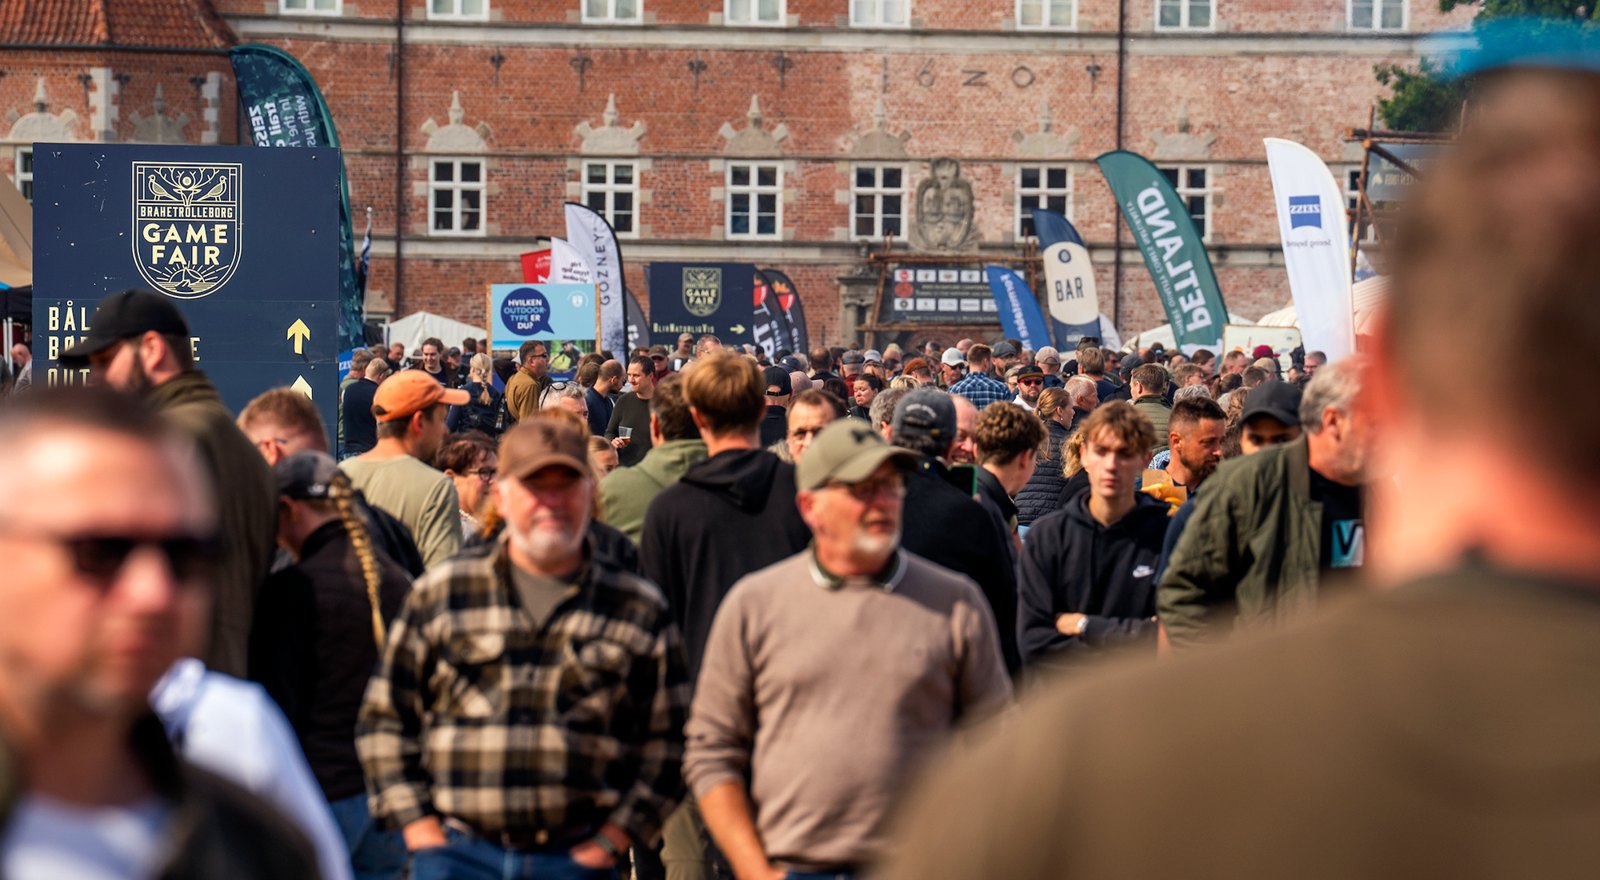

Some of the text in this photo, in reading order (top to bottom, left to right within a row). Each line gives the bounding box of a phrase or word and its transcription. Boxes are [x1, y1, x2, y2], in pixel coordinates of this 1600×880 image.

[140, 206, 233, 218] BRAHETROLLEBORG
[143, 223, 228, 244] GAME
[152, 245, 220, 266] FAIR
[593, 233, 611, 306] GOZNEY
[686, 289, 717, 297] GAME
[1055, 277, 1084, 302] BAR
[507, 298, 542, 307] HVILKEN
[688, 297, 714, 305] FAIR
[48, 300, 92, 331] BÅL
[517, 322, 534, 330] DU?
